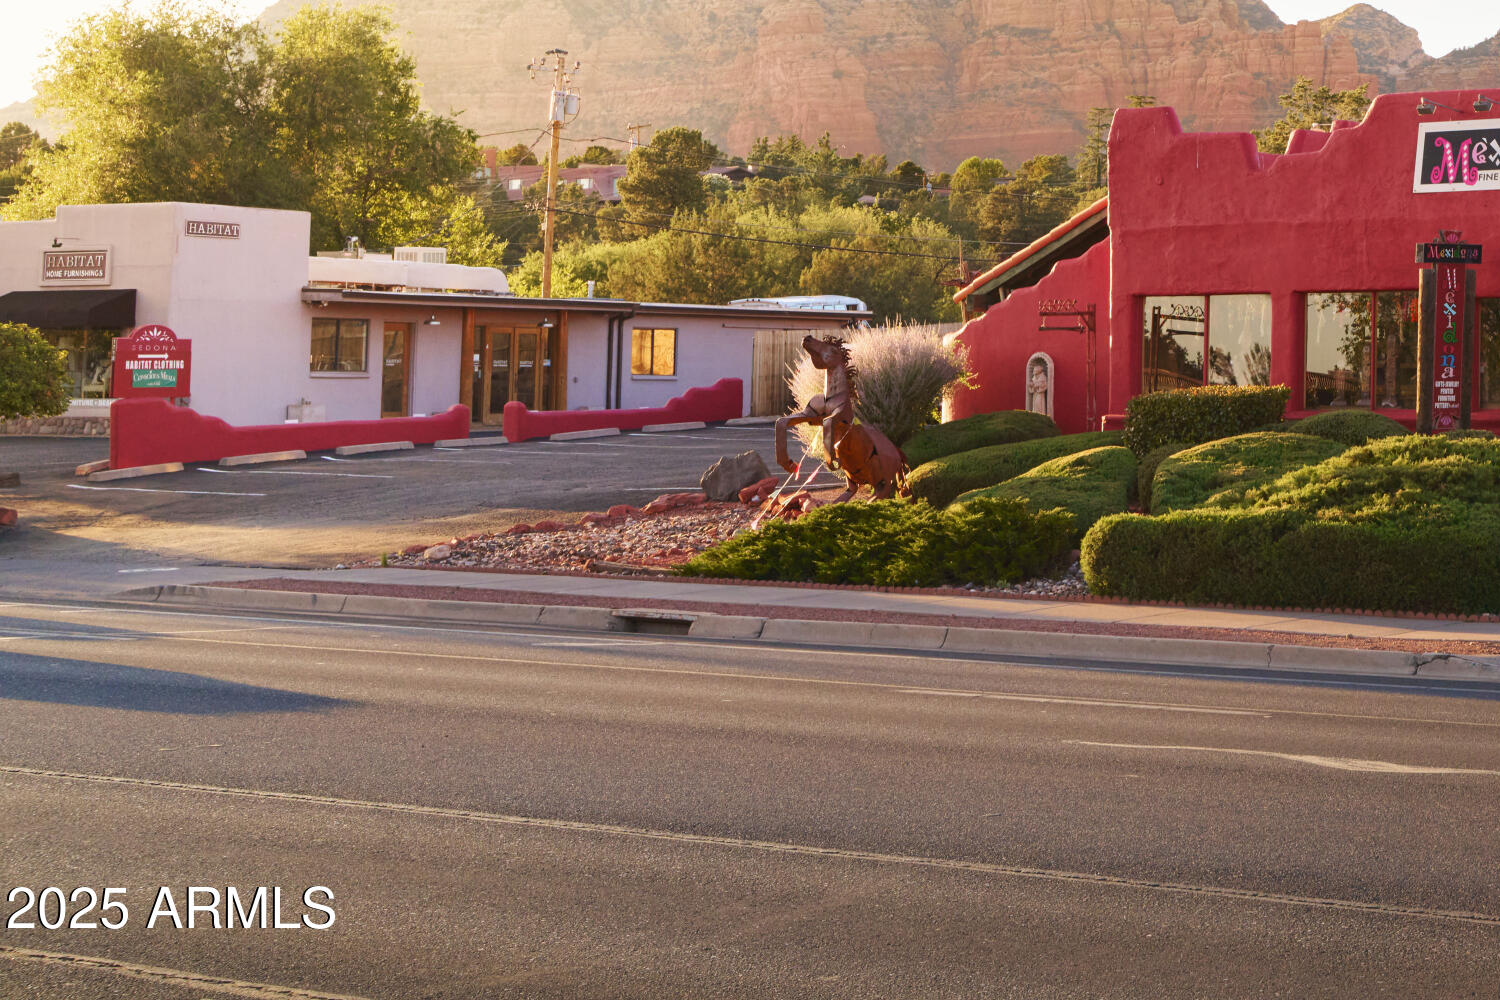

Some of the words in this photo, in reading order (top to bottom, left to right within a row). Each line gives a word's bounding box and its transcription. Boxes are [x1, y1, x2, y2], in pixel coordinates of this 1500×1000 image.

[1478, 173, 1499, 182] FINE
[188, 222, 240, 237] HABITAT
[1426, 244, 1479, 260] Mexidona
[46, 255, 104, 269] HABITAT
[46, 269, 63, 278] HOME
[63, 269, 104, 278] FURNISHINGS
[1440, 267, 1460, 379] Mexidona
[131, 344, 177, 352] SEDONA
[125, 359, 153, 370] HABITAT
[153, 359, 185, 370] CLOTHING
